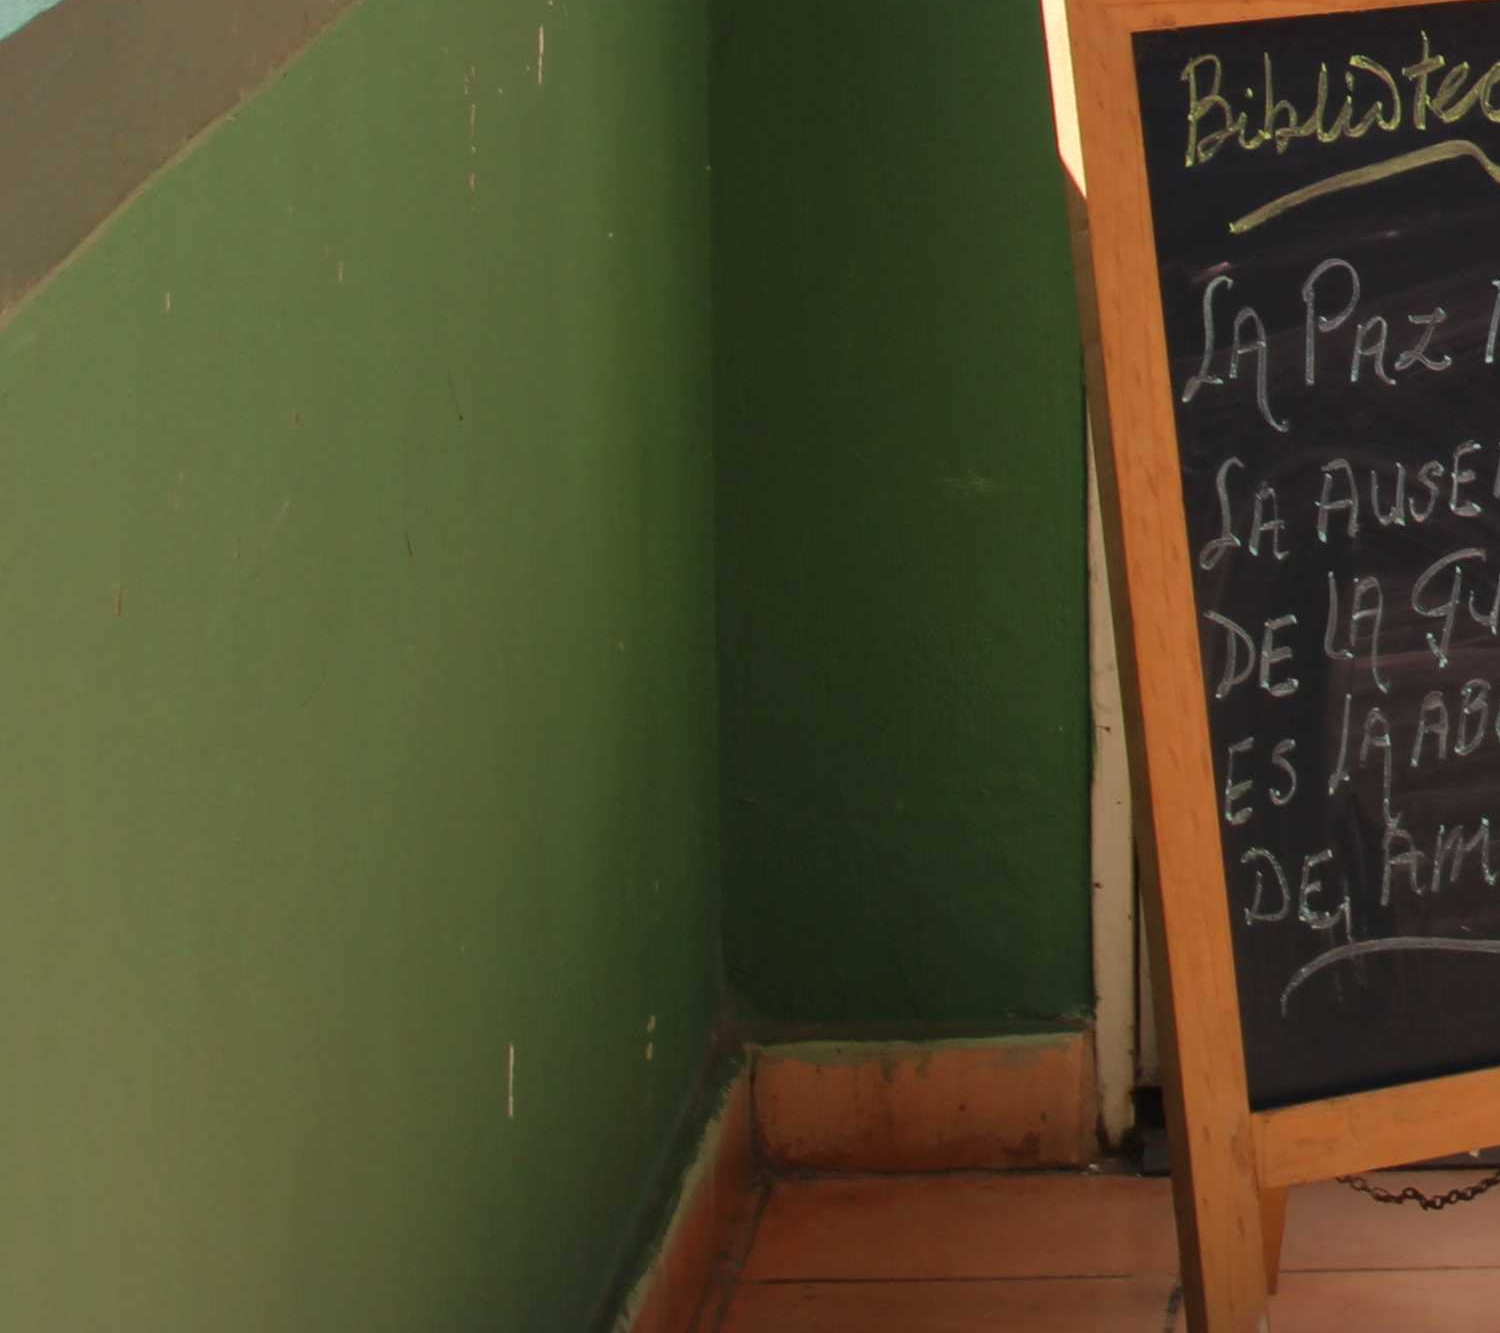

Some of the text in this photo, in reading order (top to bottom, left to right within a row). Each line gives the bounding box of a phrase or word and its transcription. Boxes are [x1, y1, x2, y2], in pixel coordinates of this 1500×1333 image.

[1181, 274, 1290, 433] LA
[1200, 456, 1290, 570] LA
[1203, 610, 1299, 699] DE
[1323, 570, 1389, 694] LA
[1223, 737, 1298, 825] ES
[1328, 693, 1401, 825] LA
